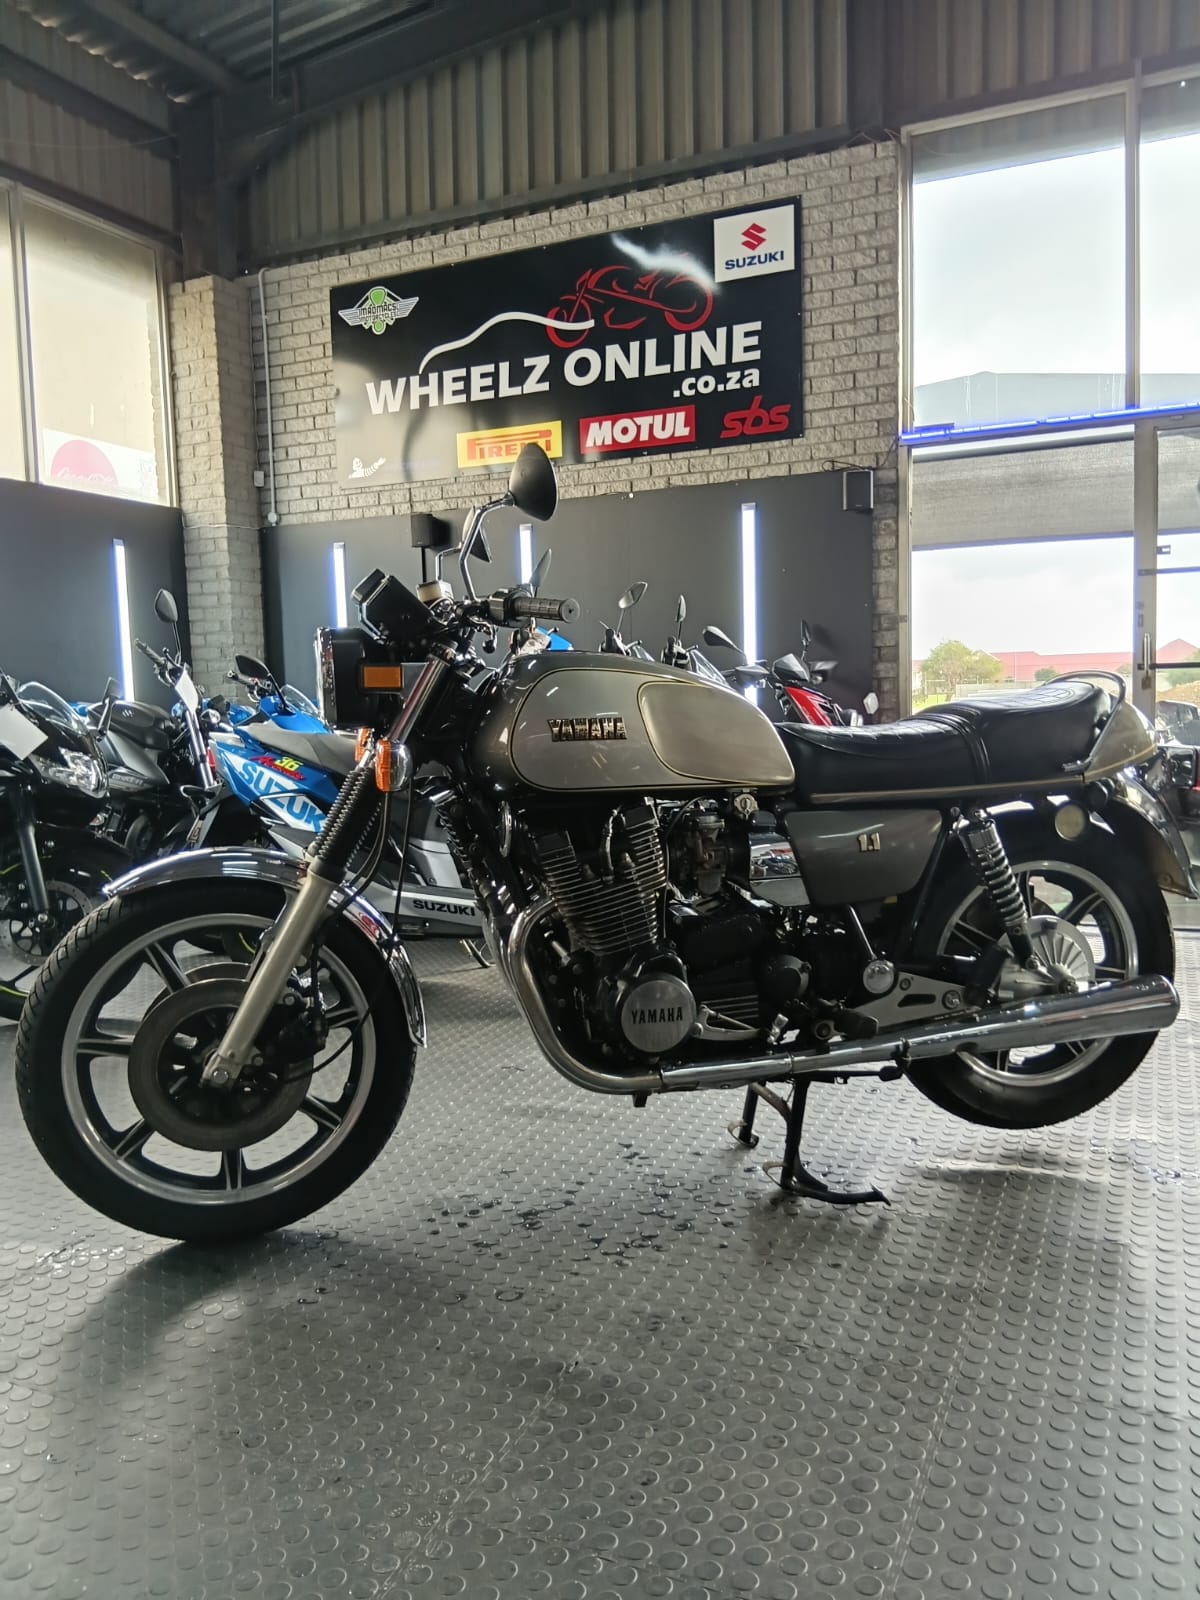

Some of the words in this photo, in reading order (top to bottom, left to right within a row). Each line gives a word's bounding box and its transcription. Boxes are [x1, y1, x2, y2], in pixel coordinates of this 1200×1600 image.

[724, 250, 784, 270] SUZUKI
[365, 354, 551, 416] WHEELZ
[563, 320, 763, 388] ONLINE
[672, 366, 761, 398] .co.za
[585, 411, 691, 448] MOTUL
[720, 395, 792, 439] sbs
[467, 429, 553, 460] PIREI
[547, 717, 627, 742] YAMAHA
[274, 756, 304, 772] 36
[240, 762, 329, 833] SUZUK
[857, 831, 881, 852] 1.1
[413, 899, 476, 917] SUZUKI
[631, 1006, 684, 1025] YAMAHA
